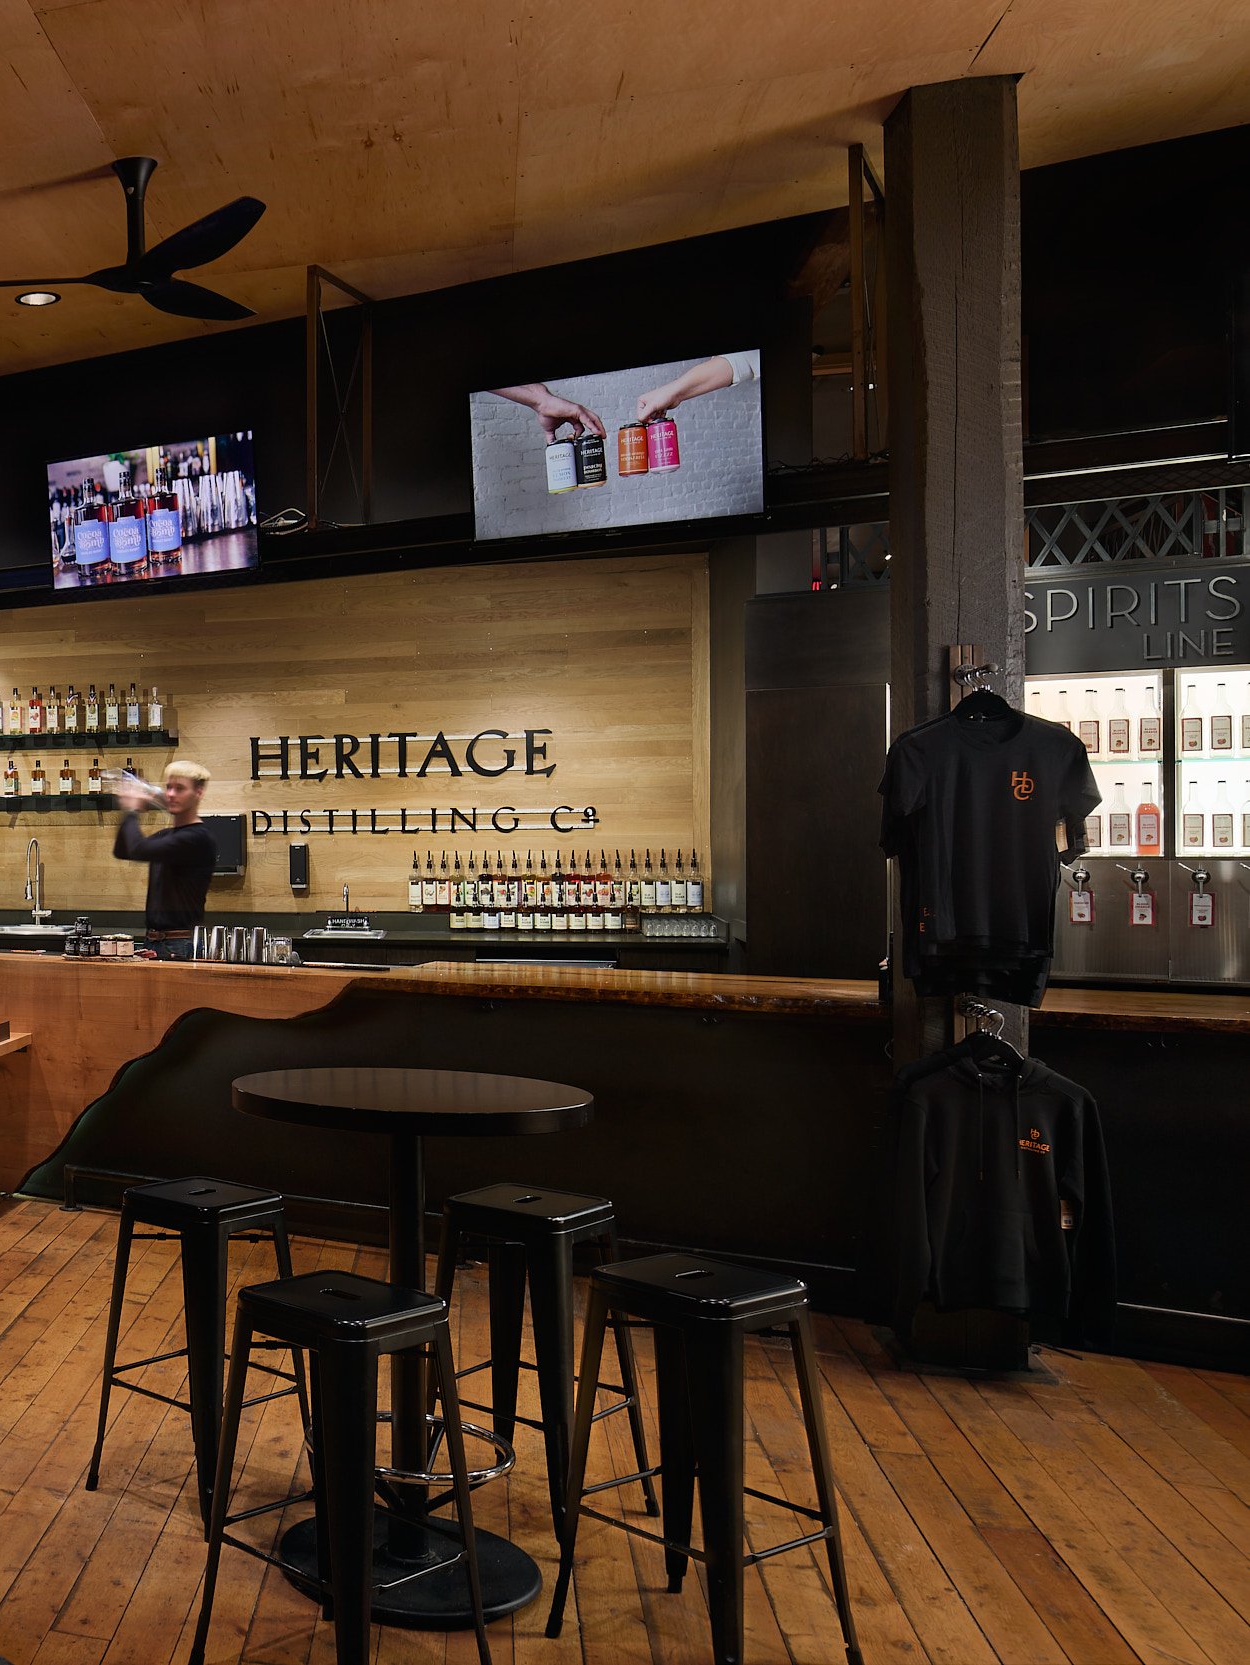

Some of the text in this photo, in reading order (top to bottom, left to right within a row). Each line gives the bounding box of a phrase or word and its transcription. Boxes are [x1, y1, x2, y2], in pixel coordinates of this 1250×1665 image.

[1143, 627, 1234, 659] LINE
[250, 728, 557, 782] HERITAGE
[251, 806, 520, 835] DISTILLING
